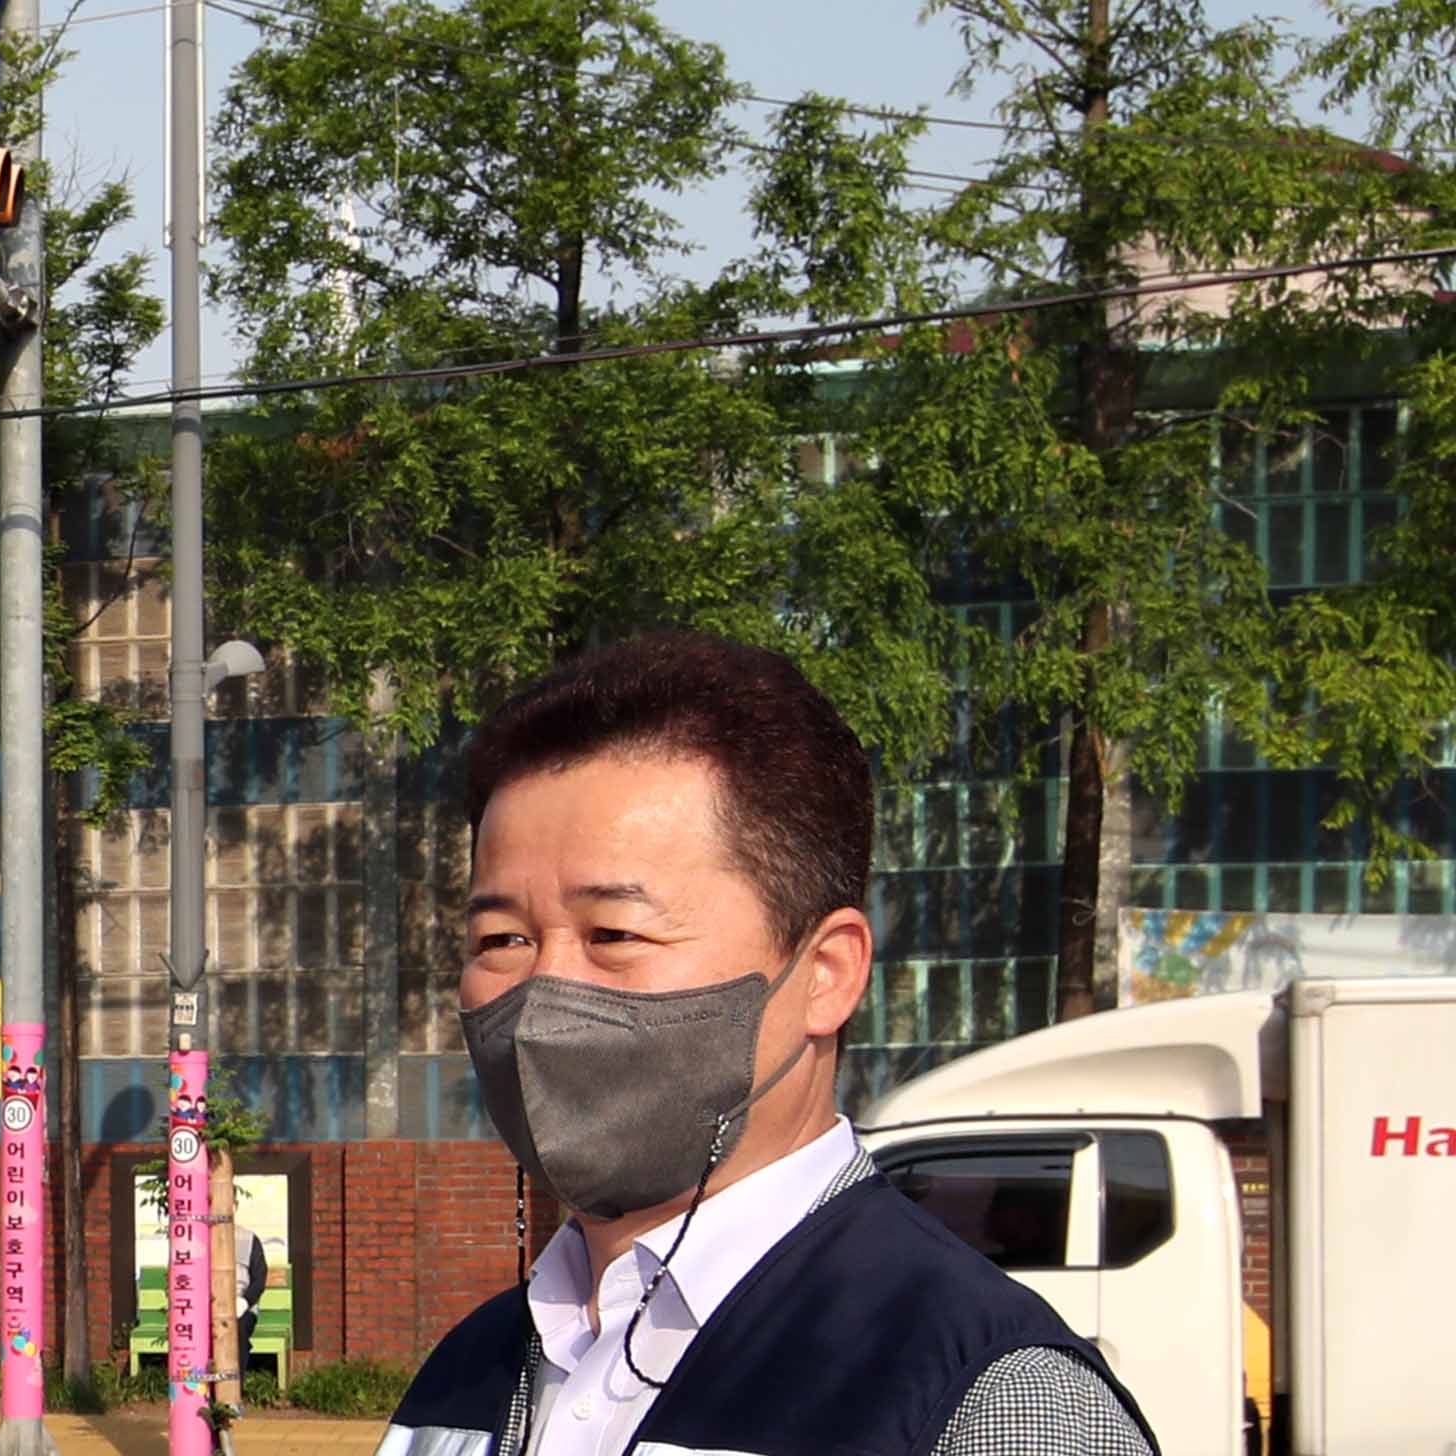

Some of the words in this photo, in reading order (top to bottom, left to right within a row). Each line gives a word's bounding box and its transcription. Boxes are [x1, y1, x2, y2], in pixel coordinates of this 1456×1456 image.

[7, 1106, 26, 1124] 30
[1370, 1116, 1456, 1157] Ha
[174, 1138, 193, 1156] 30
